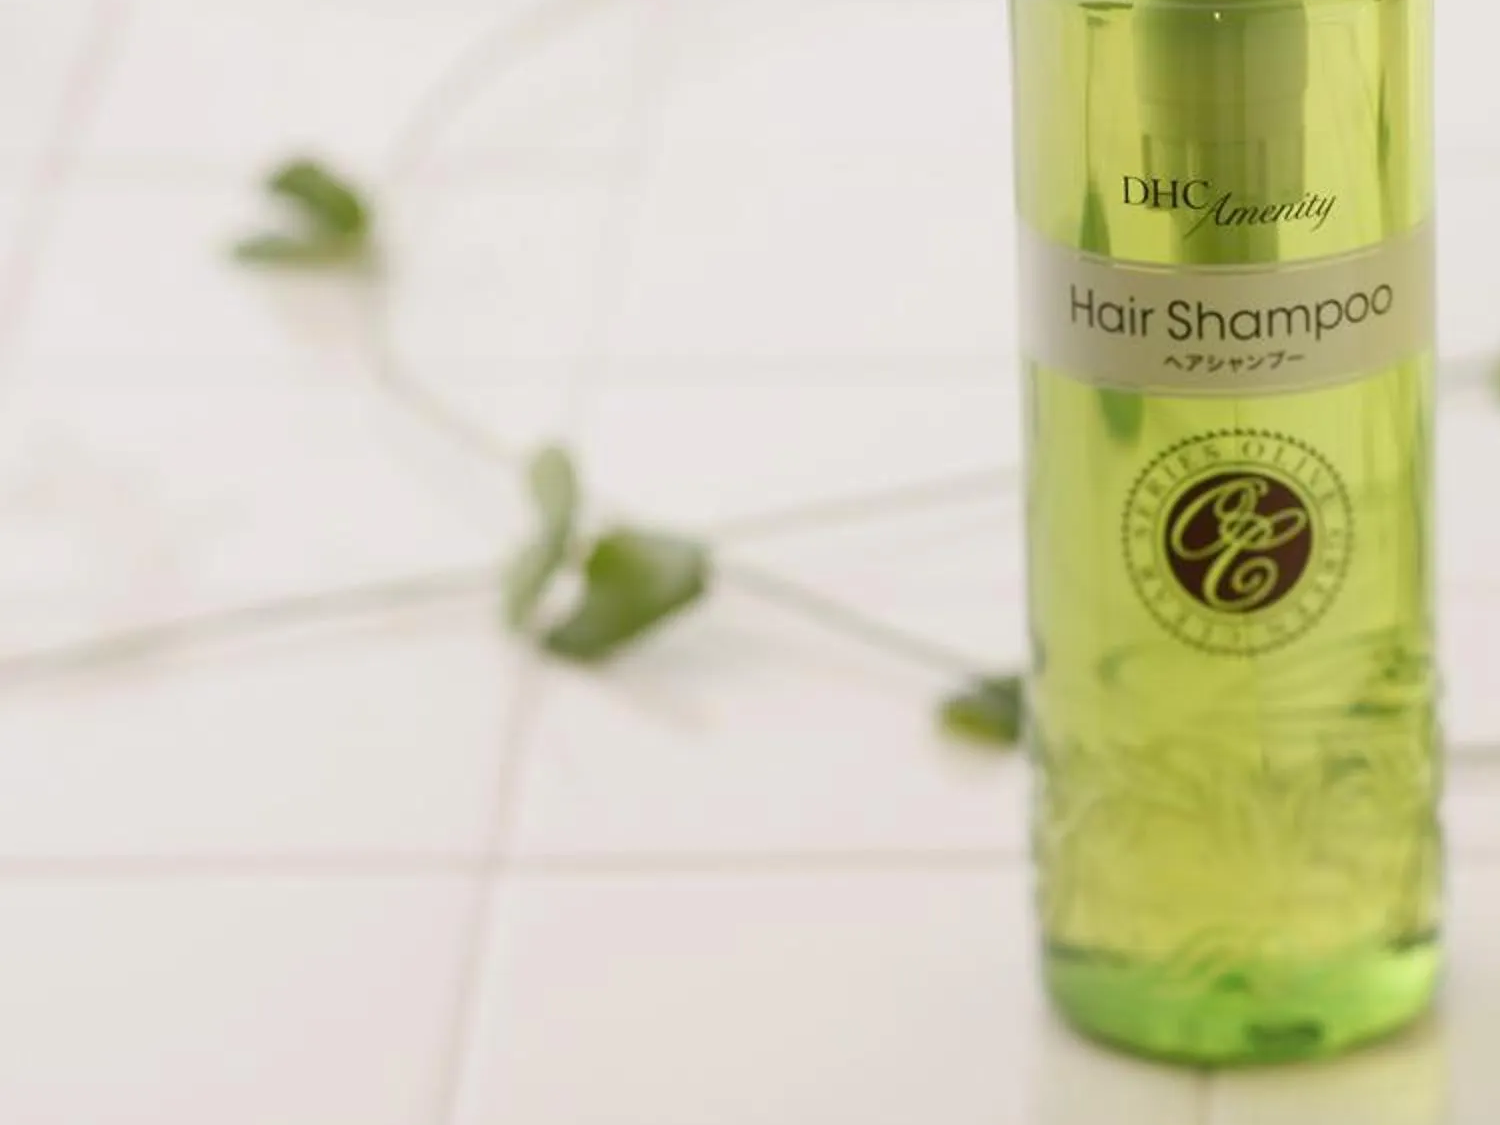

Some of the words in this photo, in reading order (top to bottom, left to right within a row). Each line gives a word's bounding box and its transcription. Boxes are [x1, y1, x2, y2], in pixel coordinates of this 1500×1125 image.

[1122, 175, 1209, 210] DHC
[1183, 192, 1337, 239] Amenity
[1069, 284, 1154, 338] Hair
[1167, 284, 1394, 342] Shampoo
